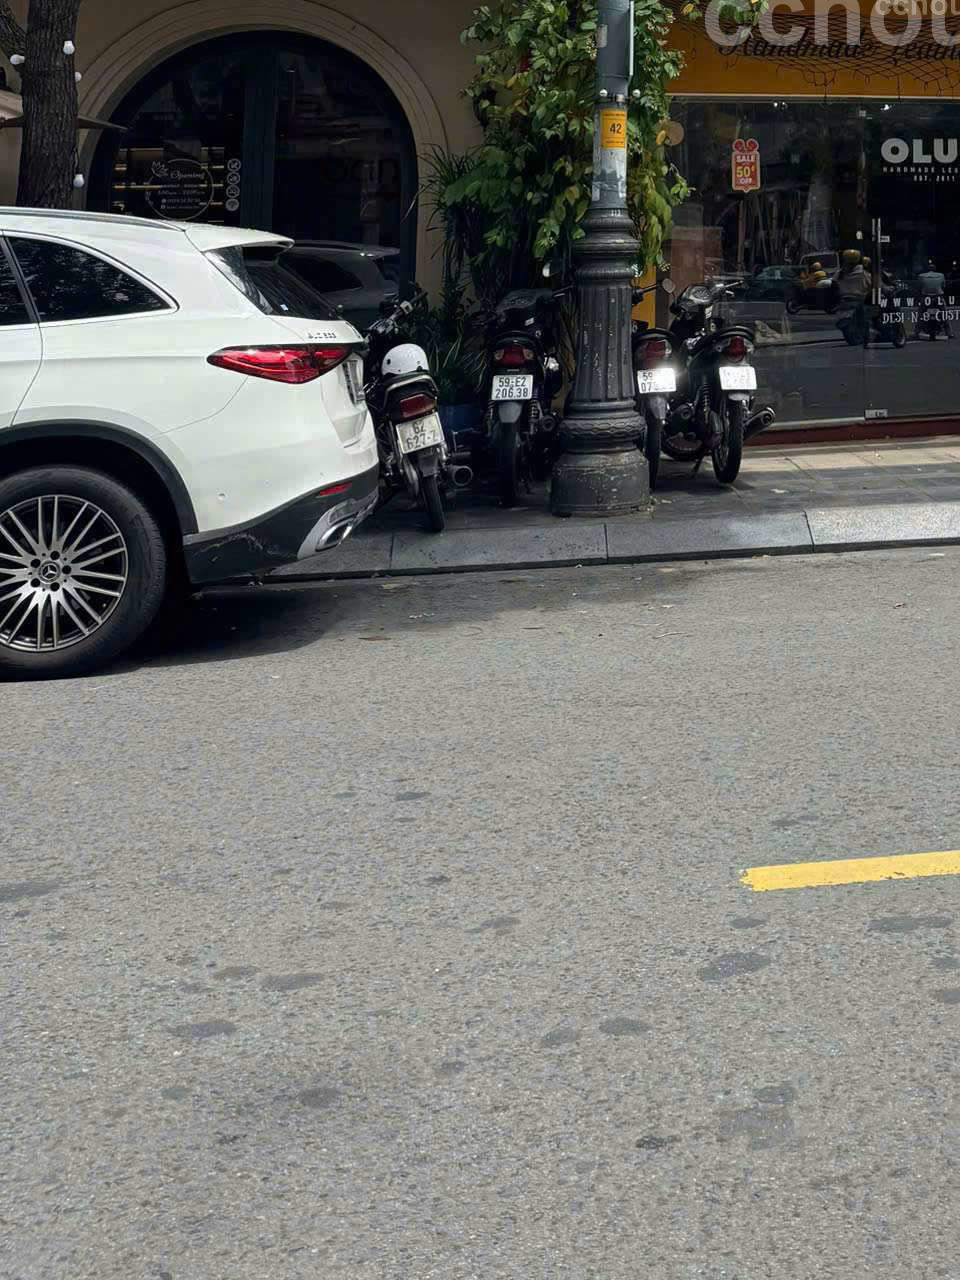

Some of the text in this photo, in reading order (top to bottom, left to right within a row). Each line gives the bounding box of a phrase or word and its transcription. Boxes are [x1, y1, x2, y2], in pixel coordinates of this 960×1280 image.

[609, 122, 622, 135] 42
[736, 154, 756, 163] SALE
[882, 311, 918, 324] DESIN
[498, 376, 526, 388] 59-E2
[495, 387, 529, 399] 206.38
